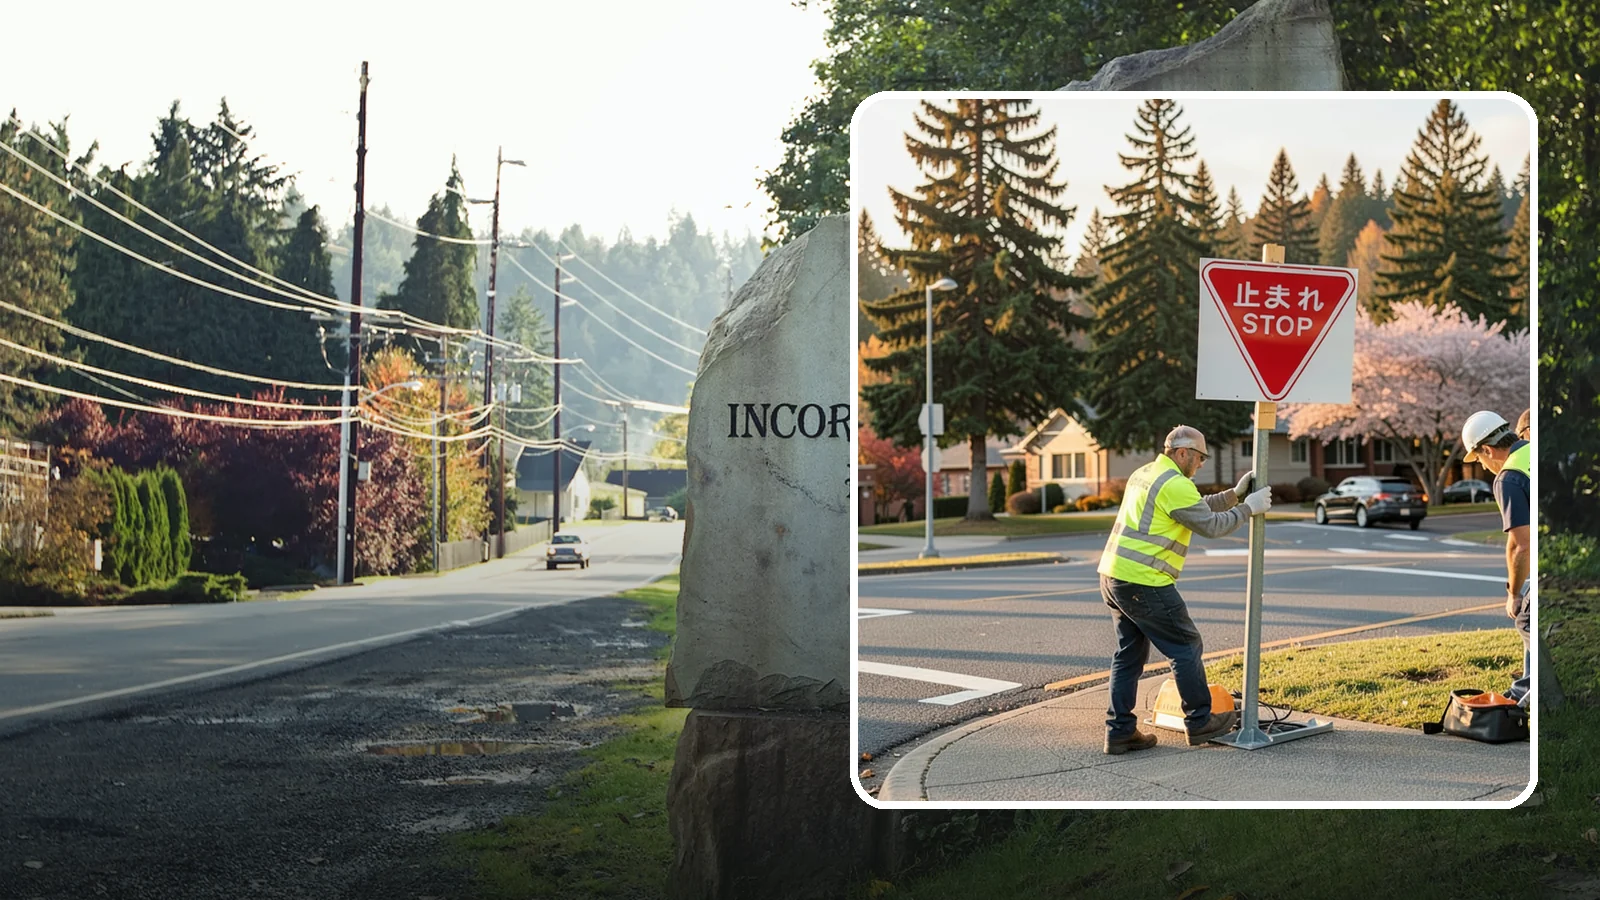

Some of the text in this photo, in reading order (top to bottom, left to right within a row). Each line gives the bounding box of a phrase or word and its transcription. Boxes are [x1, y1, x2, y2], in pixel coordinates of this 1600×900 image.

[1233, 281, 1325, 312] 止まれ
[1242, 313, 1313, 337] STOP
